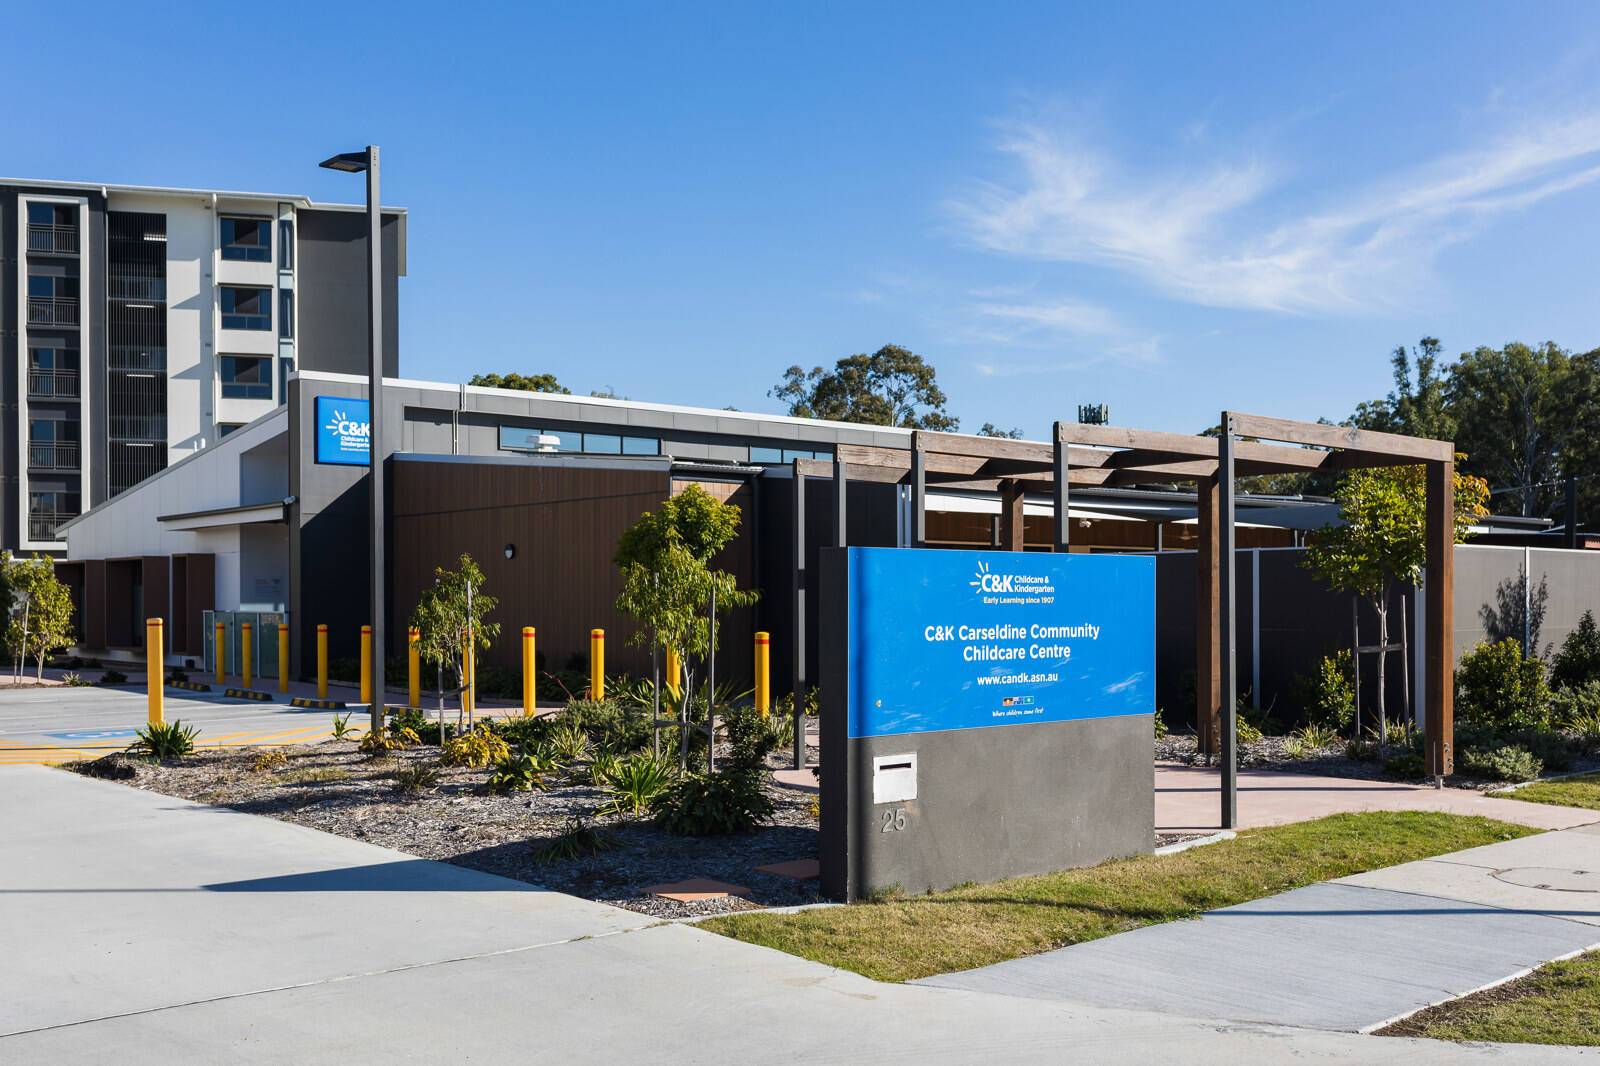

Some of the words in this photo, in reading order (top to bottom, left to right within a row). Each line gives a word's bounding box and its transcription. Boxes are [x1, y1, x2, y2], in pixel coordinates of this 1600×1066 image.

[338, 421, 369, 437] C&K
[981, 574, 1014, 593] C&K
[1014, 576, 1042, 584] Childcare
[1044, 576, 1049, 584] &
[1014, 585, 1055, 594] Kindergarten
[983, 597, 999, 605] Early
[1000, 597, 1025, 605] Learning
[924, 625, 955, 641] C&K
[958, 624, 1027, 641] Carseldine
[1030, 622, 1100, 640] Community
[963, 645, 1026, 662] Childcare
[1029, 643, 1071, 659] Centre
[977, 673, 1058, 685] www.candk.asn.au
[881, 808, 906, 833] 25
